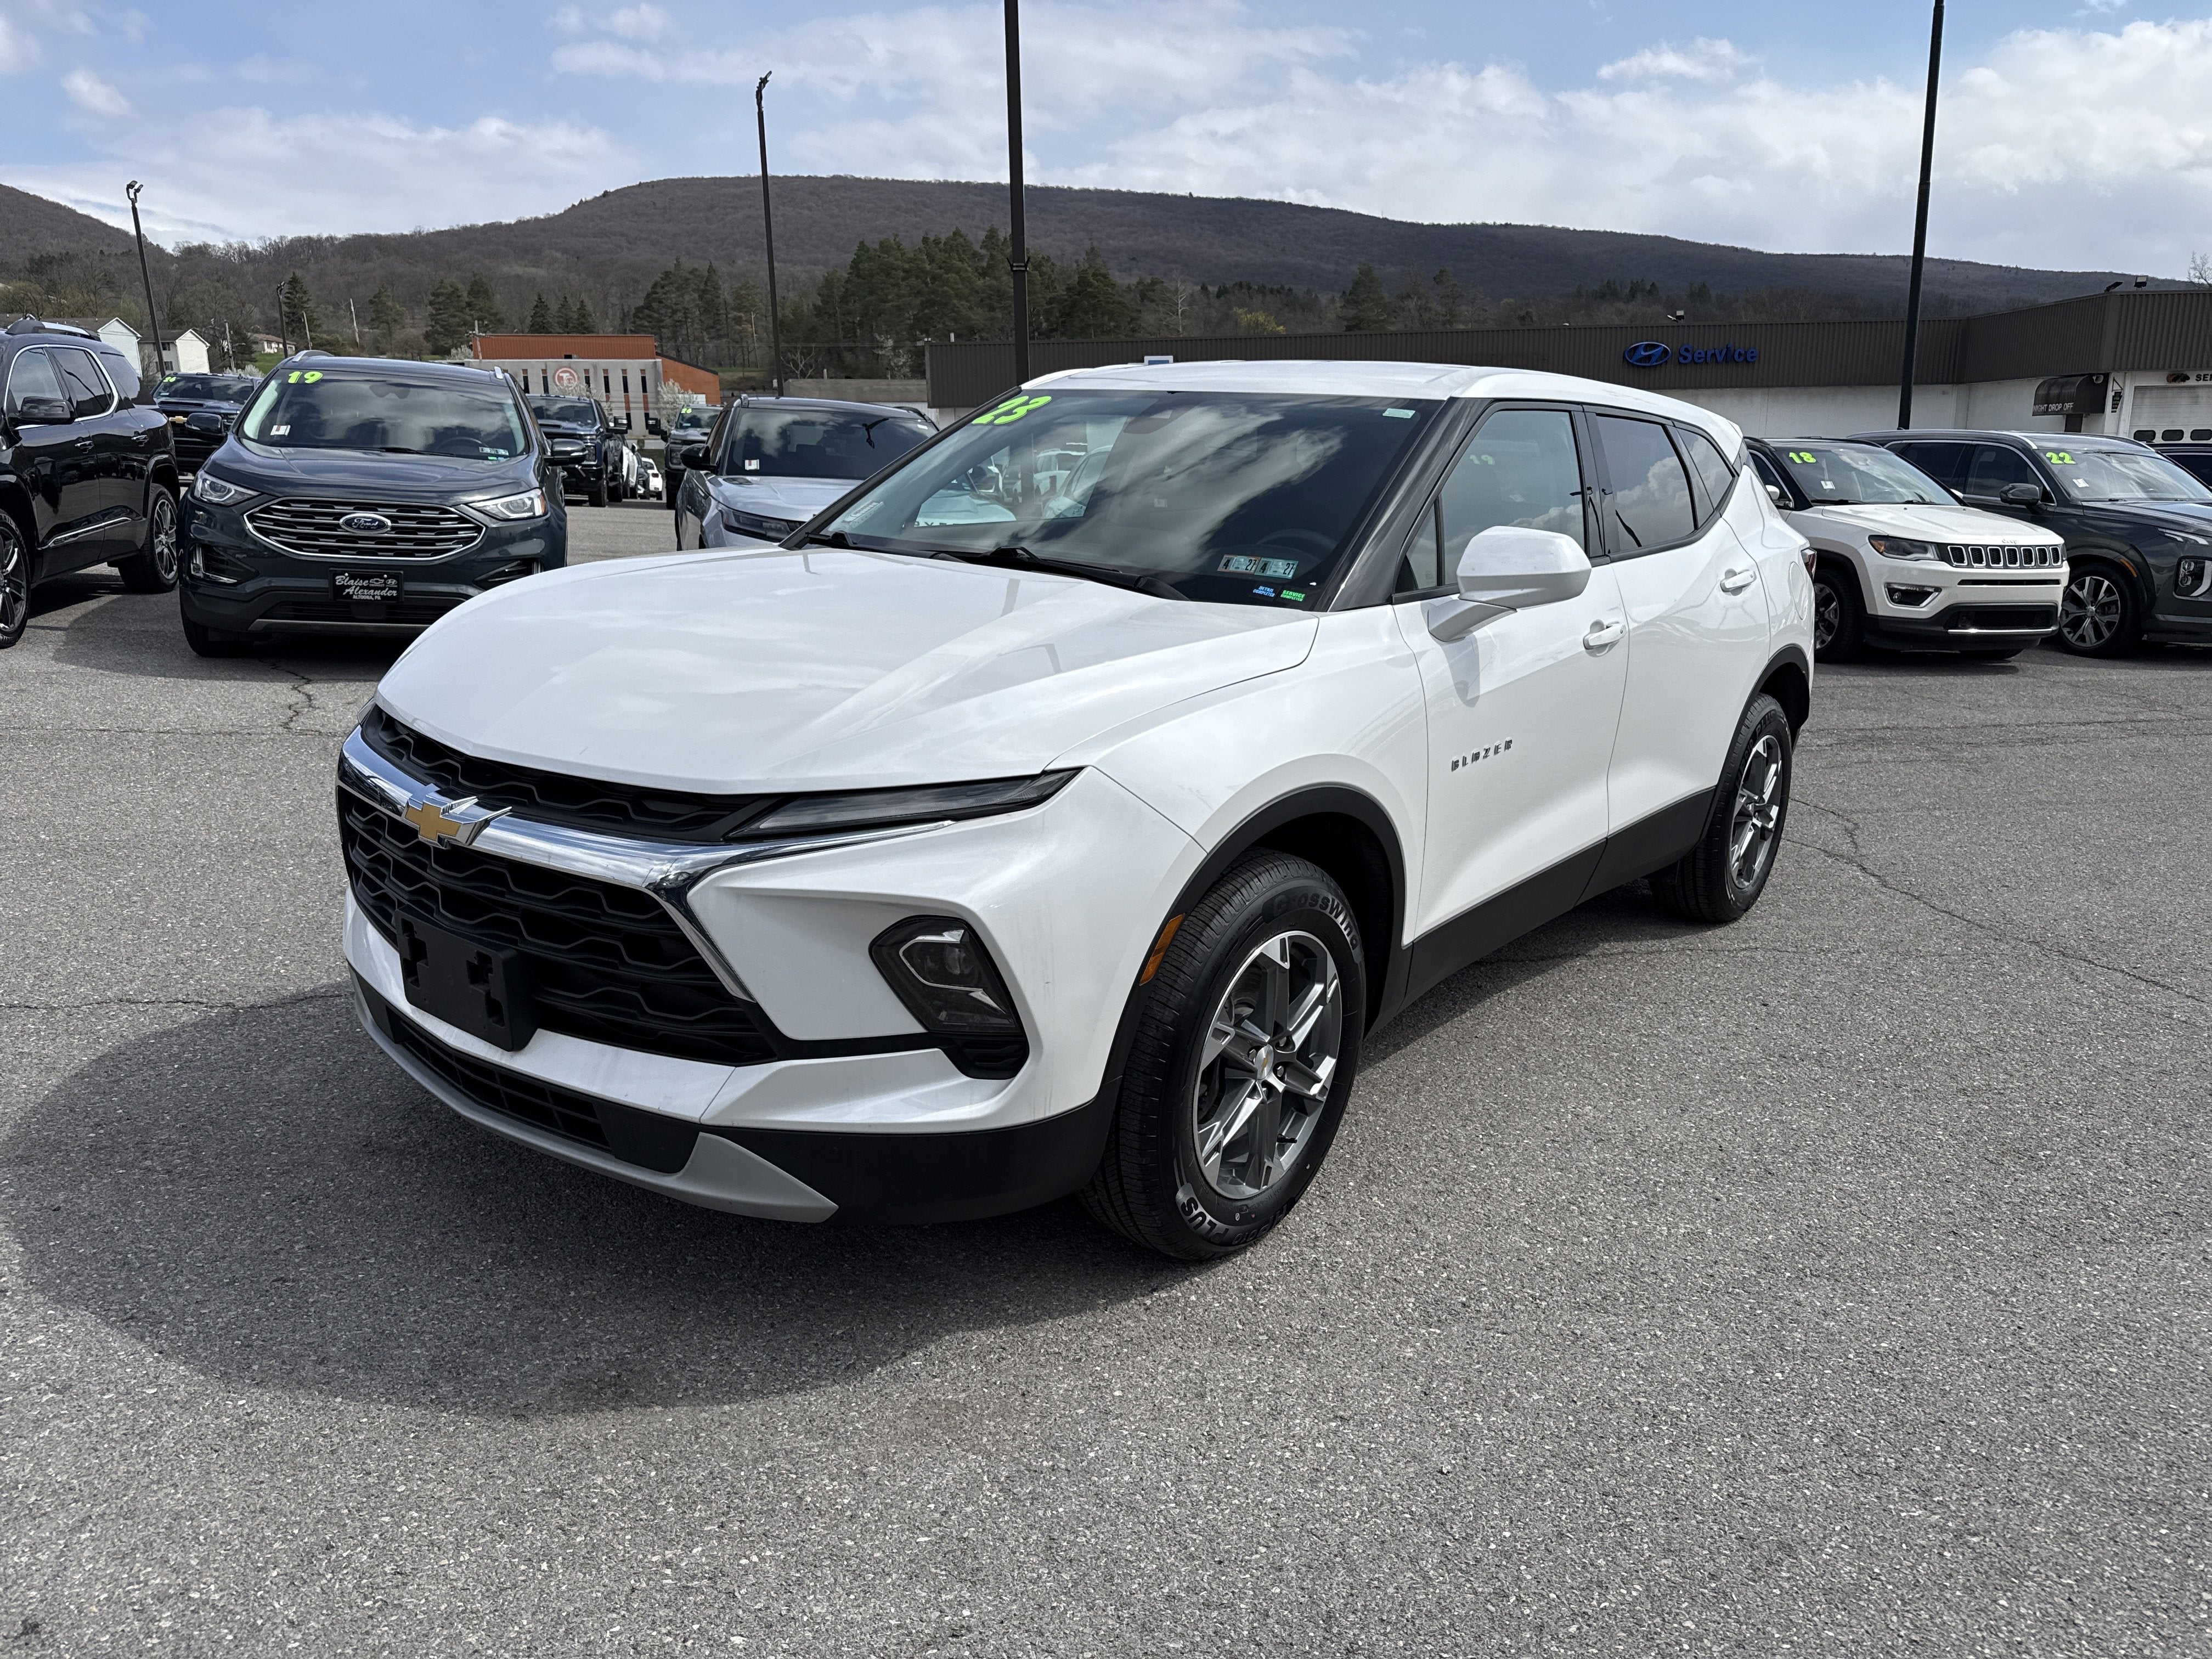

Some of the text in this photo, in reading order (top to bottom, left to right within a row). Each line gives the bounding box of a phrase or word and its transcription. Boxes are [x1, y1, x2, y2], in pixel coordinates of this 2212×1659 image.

[1678, 343, 1758, 364] Service
[287, 371, 323, 383] 19
[971, 396, 1052, 425] 23
[2033, 402, 2074, 412] NIGHT DROP OFF
[1789, 452, 1816, 464] 18
[2045, 452, 2076, 464] 22
[352, 517, 379, 529] Ford
[1223, 558, 1257, 572] 4 27
[1260, 562, 1295, 575] 4 27
[335, 575, 369, 586] Blaise
[343, 585, 398, 596] Alexander
[1282, 590, 1306, 599] SERVICE
[1451, 738, 1513, 772] BLAZER
[1181, 1197, 1229, 1244] PLUS
